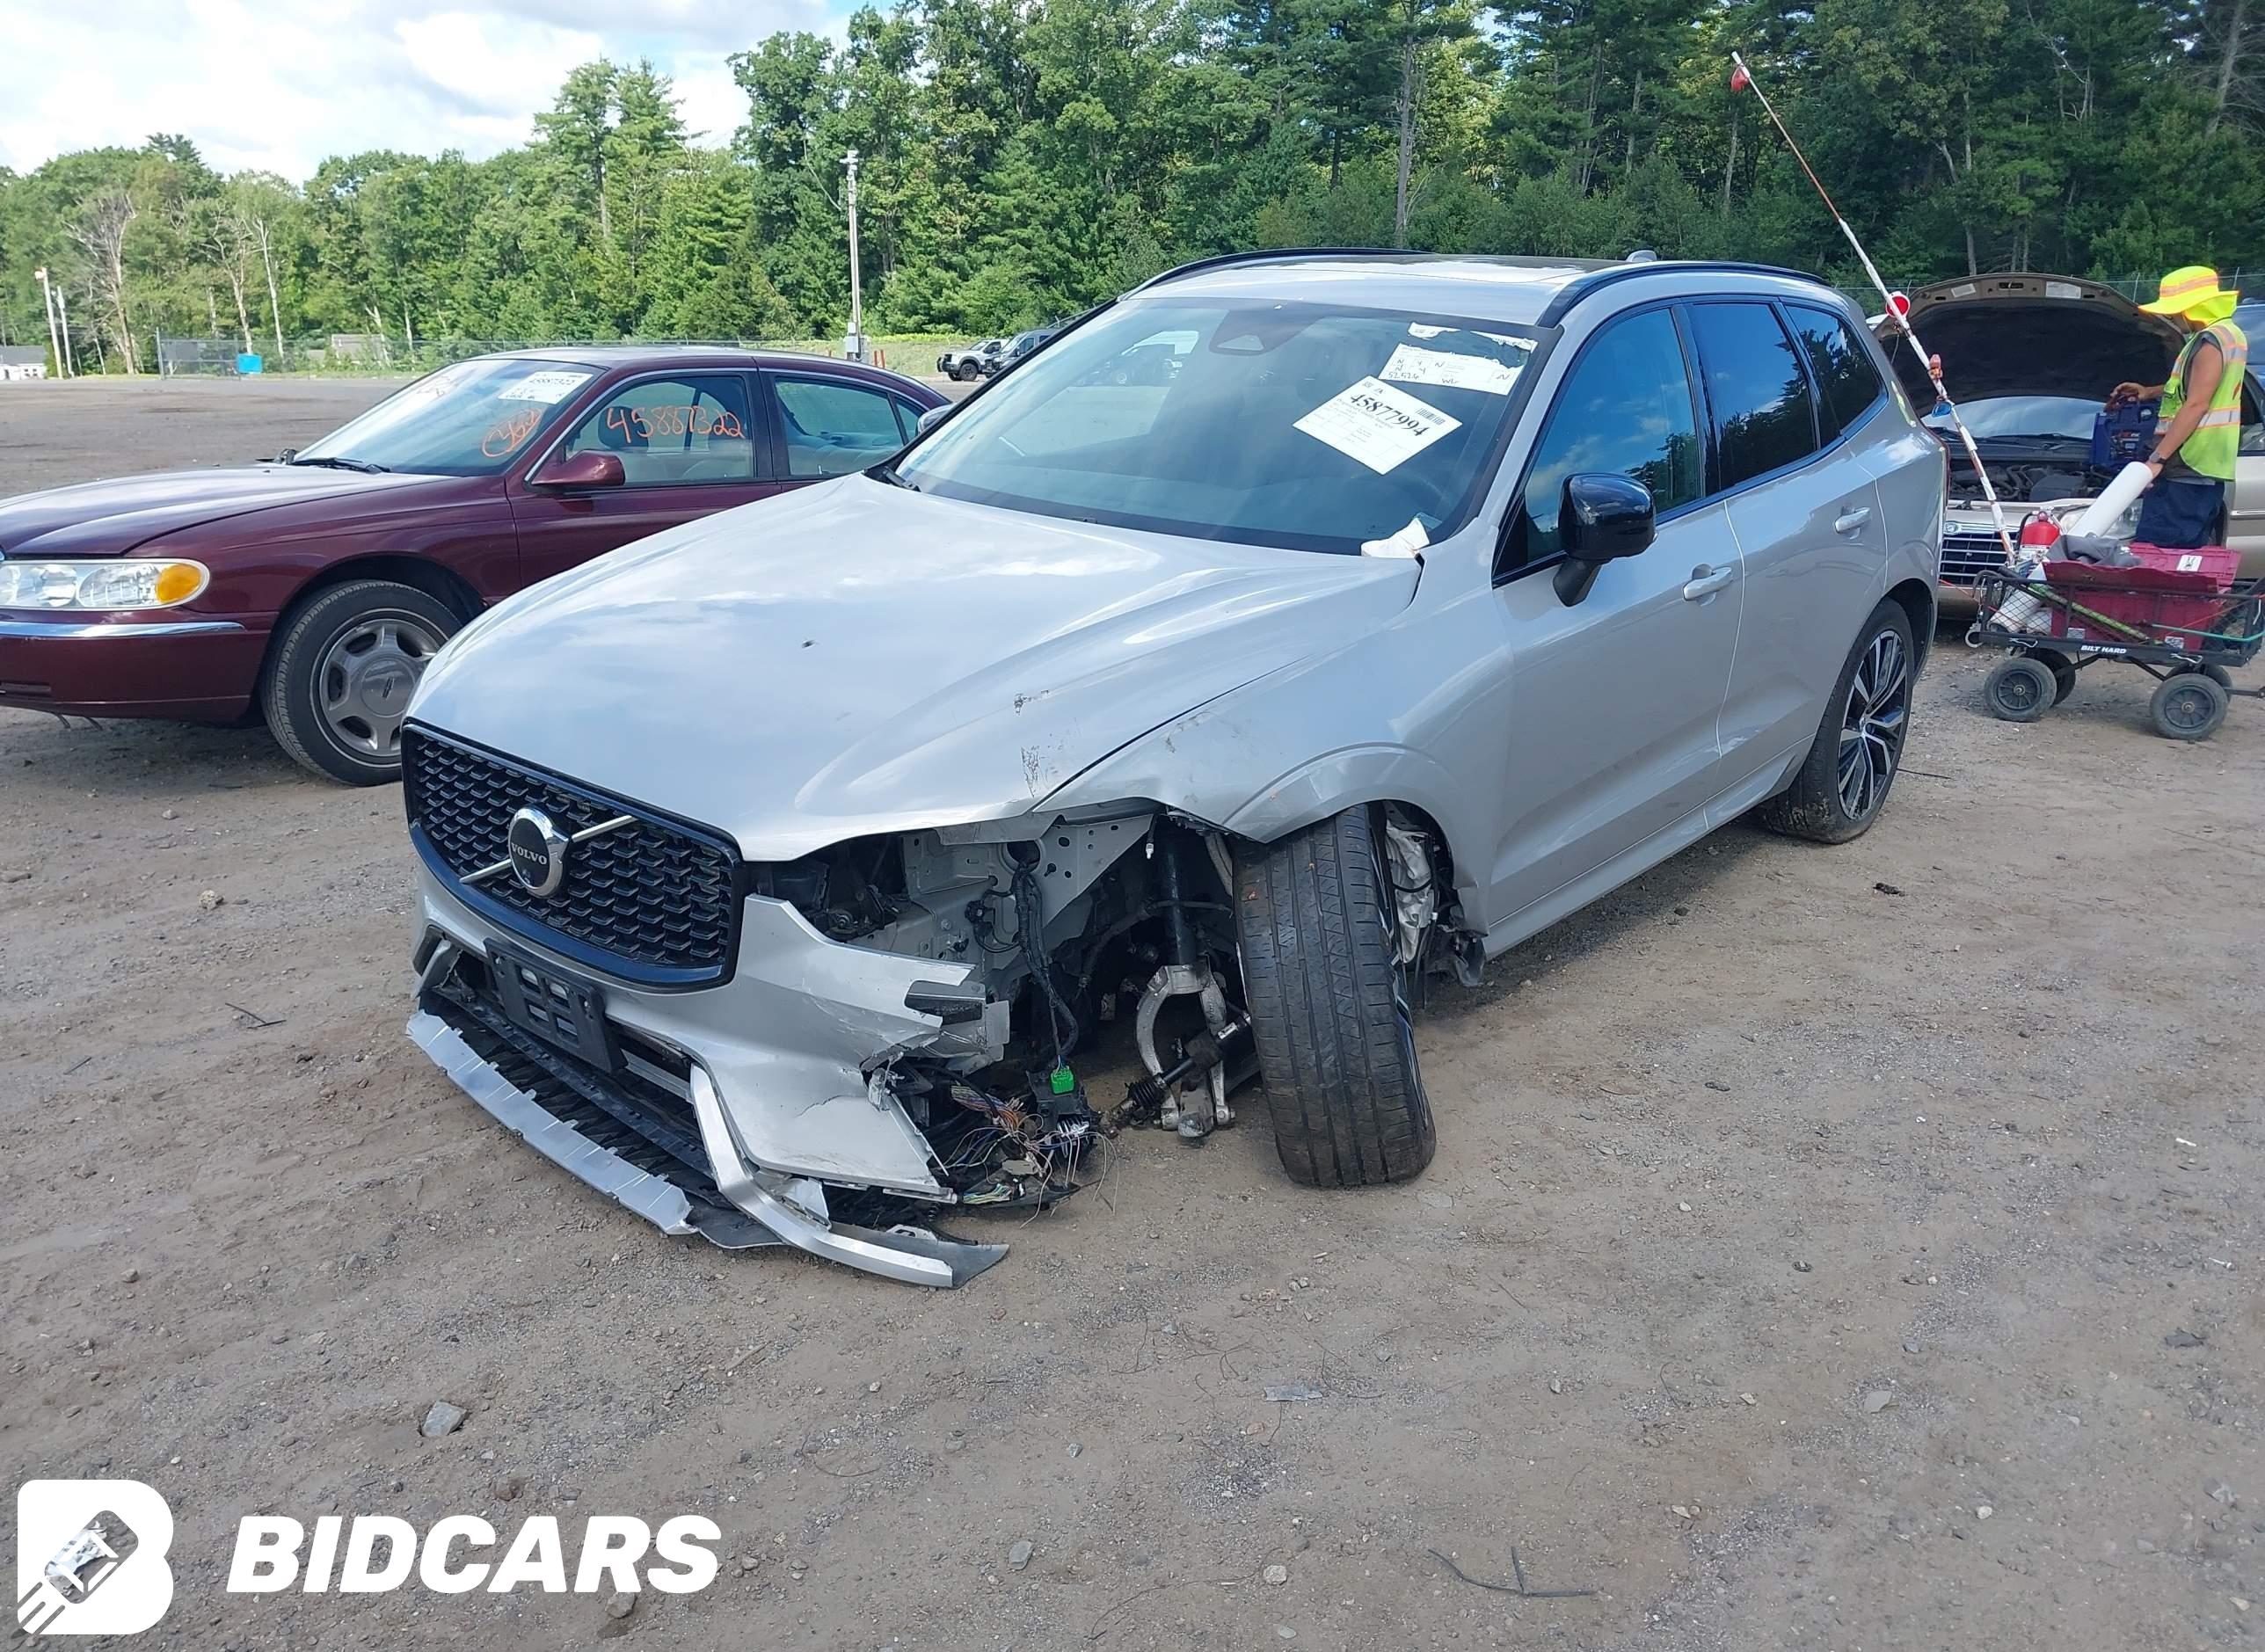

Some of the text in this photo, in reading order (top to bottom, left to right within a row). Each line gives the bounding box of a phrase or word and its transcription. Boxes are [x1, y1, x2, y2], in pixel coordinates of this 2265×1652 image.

[607, 405, 746, 443] 45887322
[1351, 394, 1430, 436] 45877994
[511, 842, 548, 865] VOLVO
